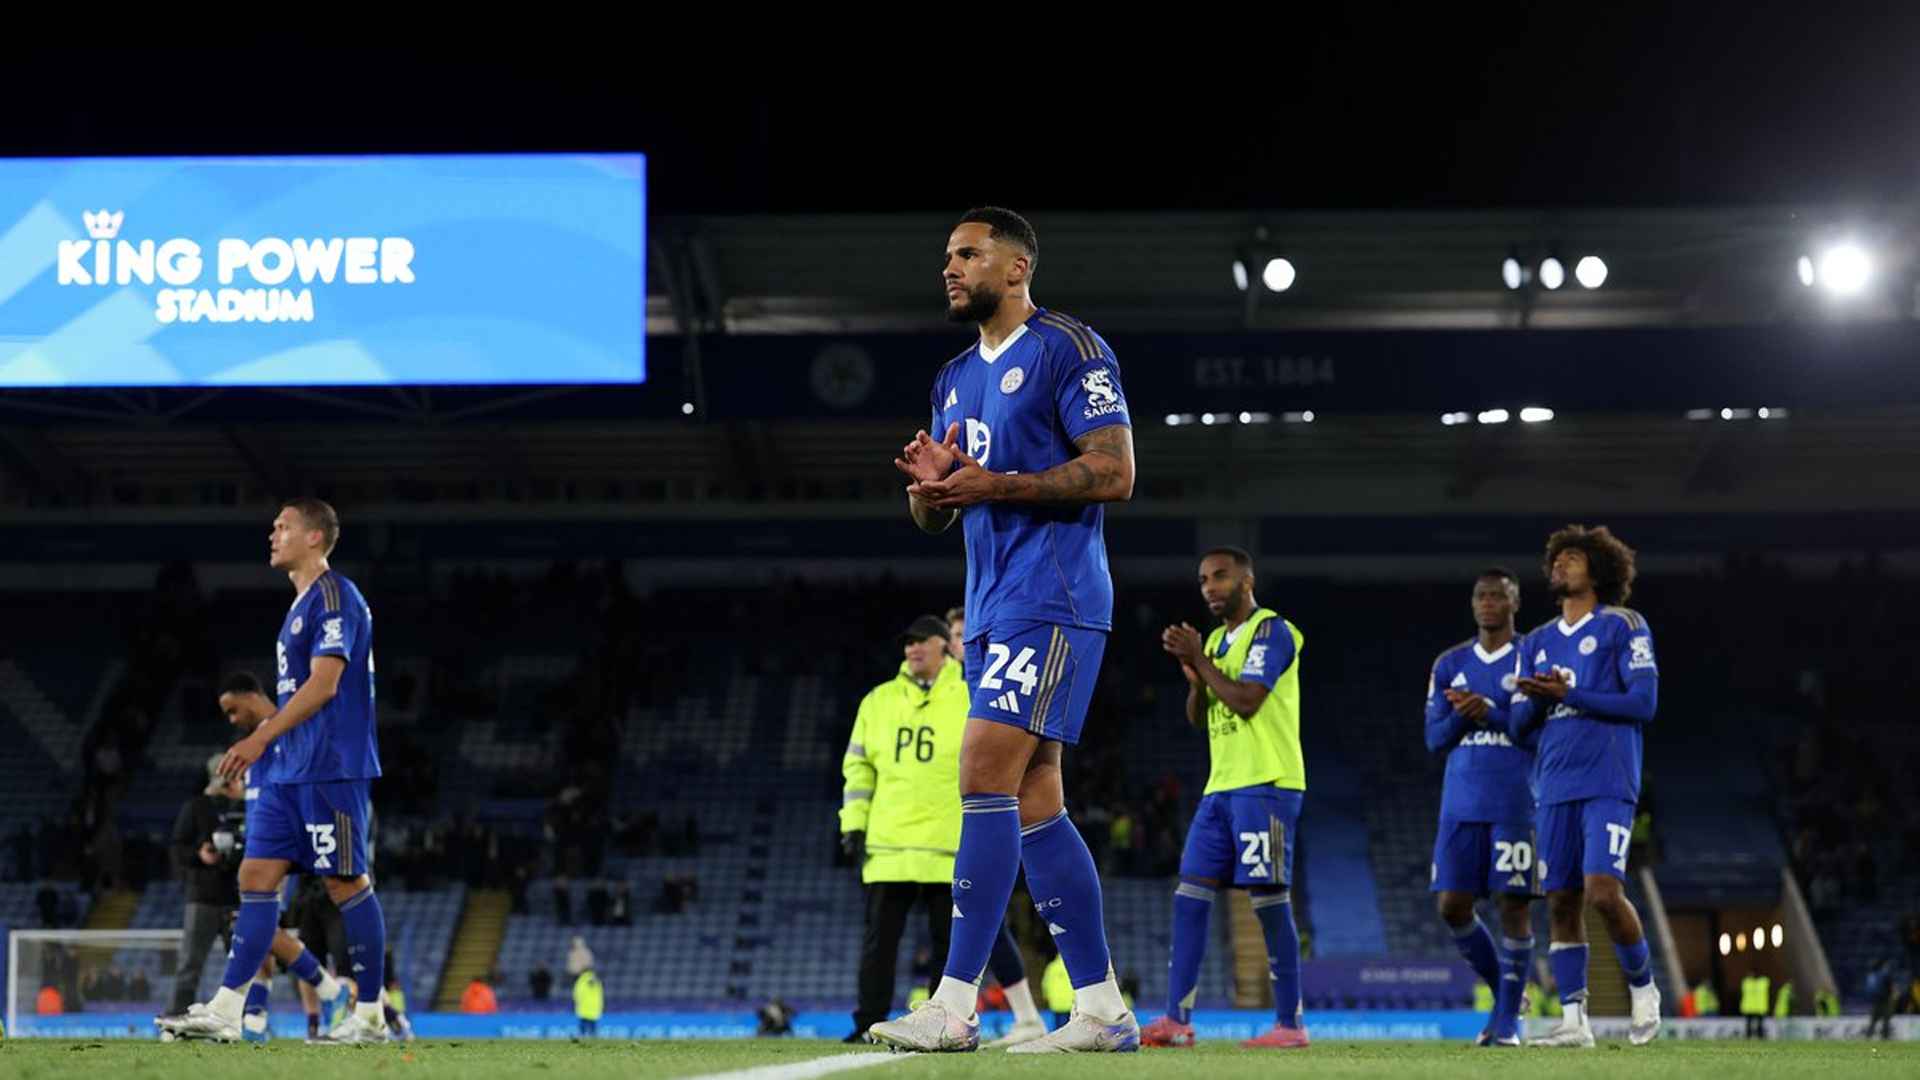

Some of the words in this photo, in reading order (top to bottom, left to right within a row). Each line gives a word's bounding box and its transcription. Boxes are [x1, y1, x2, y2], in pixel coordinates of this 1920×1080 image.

[56, 236, 203, 286] KING
[217, 236, 416, 286] POWER
[155, 288, 315, 325] STADIUM
[979, 643, 1038, 696] 24
[895, 726, 934, 764] P6
[1239, 832, 1272, 865] 21
[1494, 841, 1532, 873] 20
[1606, 822, 1632, 857] 17
